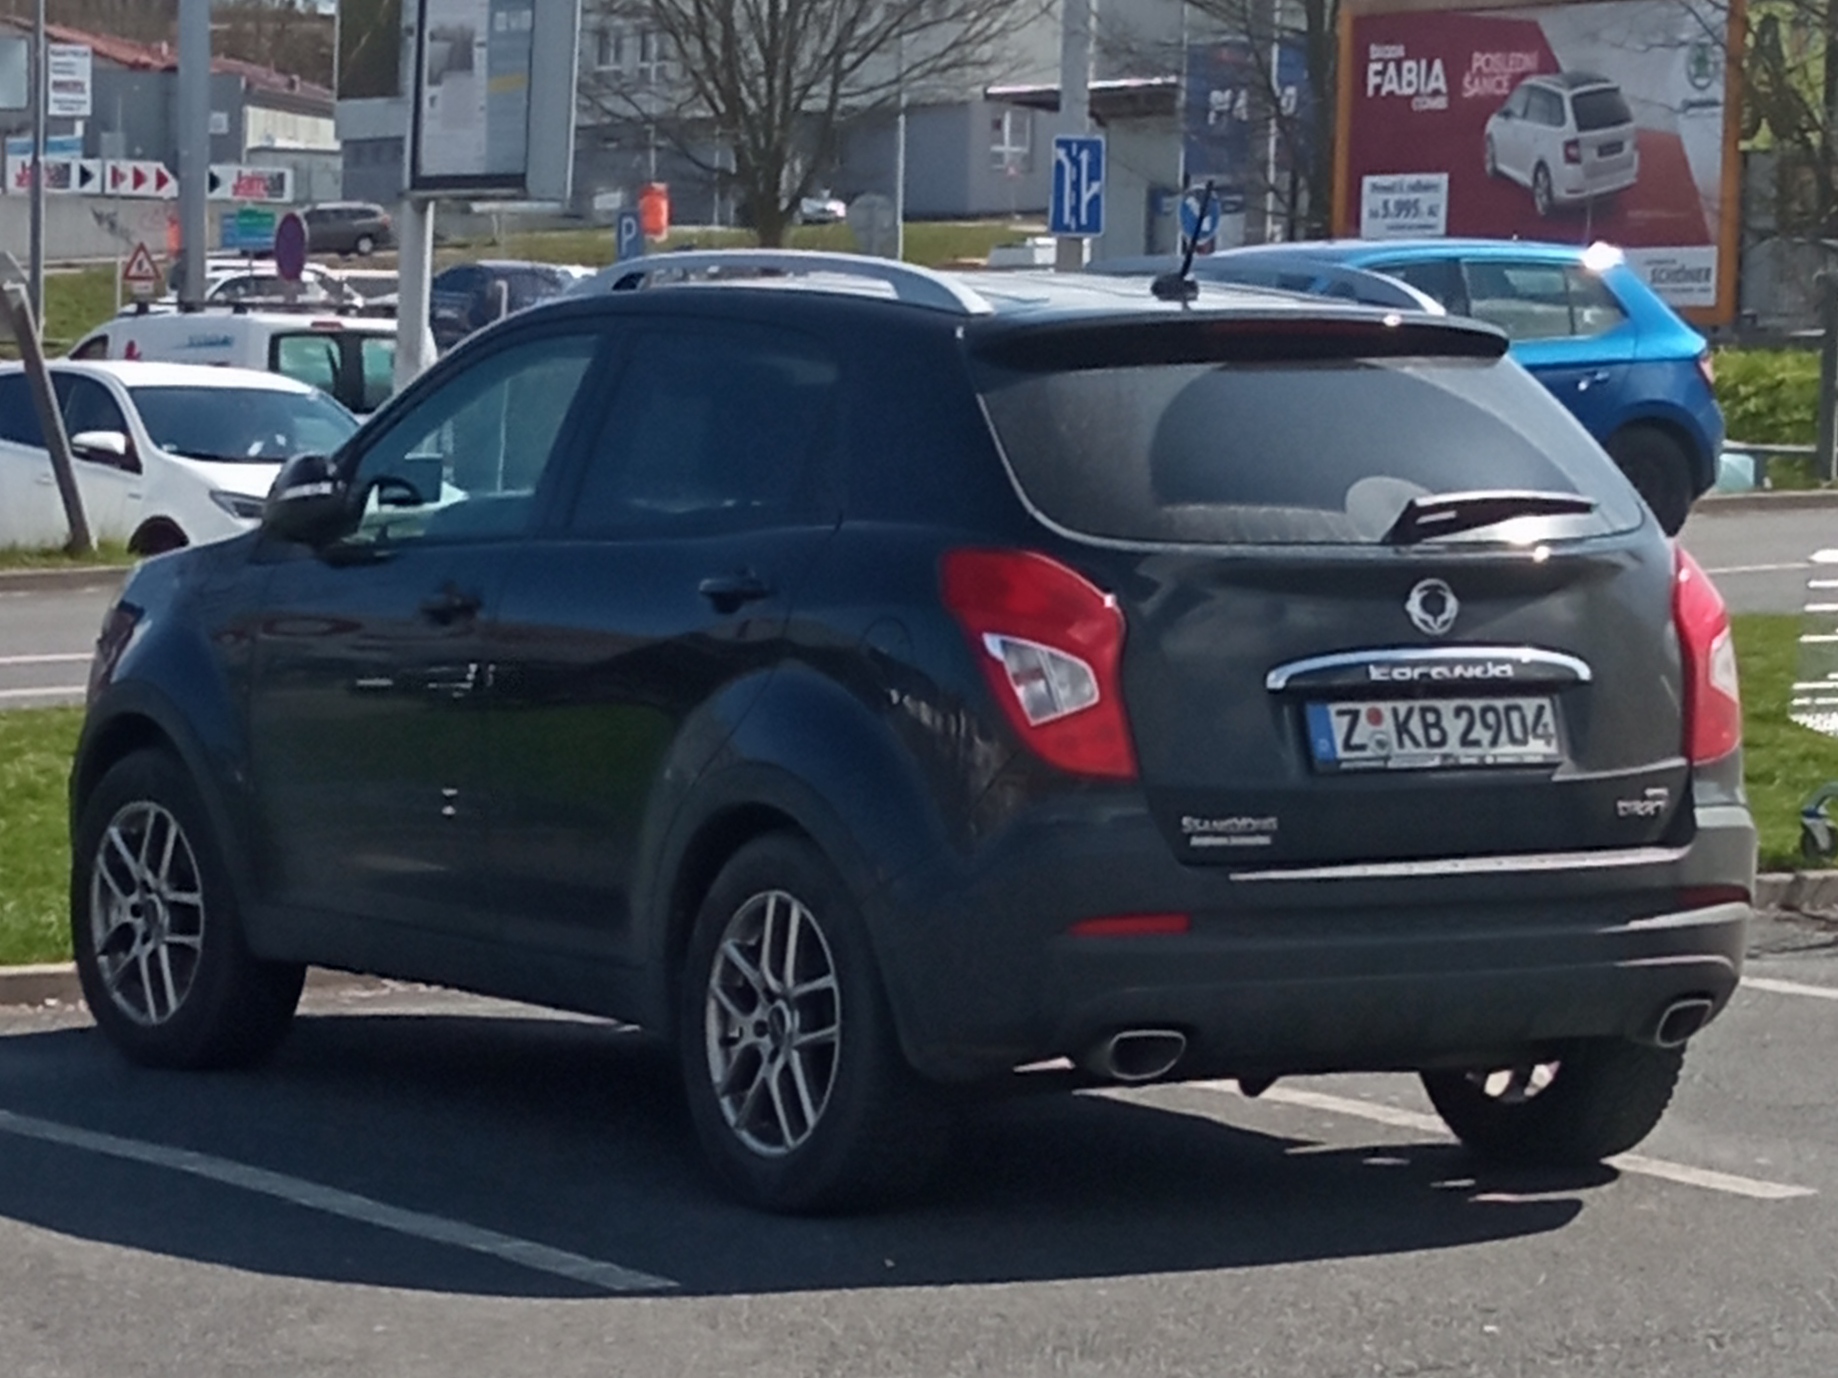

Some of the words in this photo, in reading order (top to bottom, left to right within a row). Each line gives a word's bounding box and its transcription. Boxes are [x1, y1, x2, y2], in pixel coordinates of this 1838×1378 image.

[1366, 58, 1448, 108] FABIA
[1461, 71, 1512, 98] ŠANCE
[621, 215, 637, 256] P
[1335, 708, 1368, 752] Z
[1391, 705, 1449, 749] KB
[1453, 703, 1554, 749] 2904
